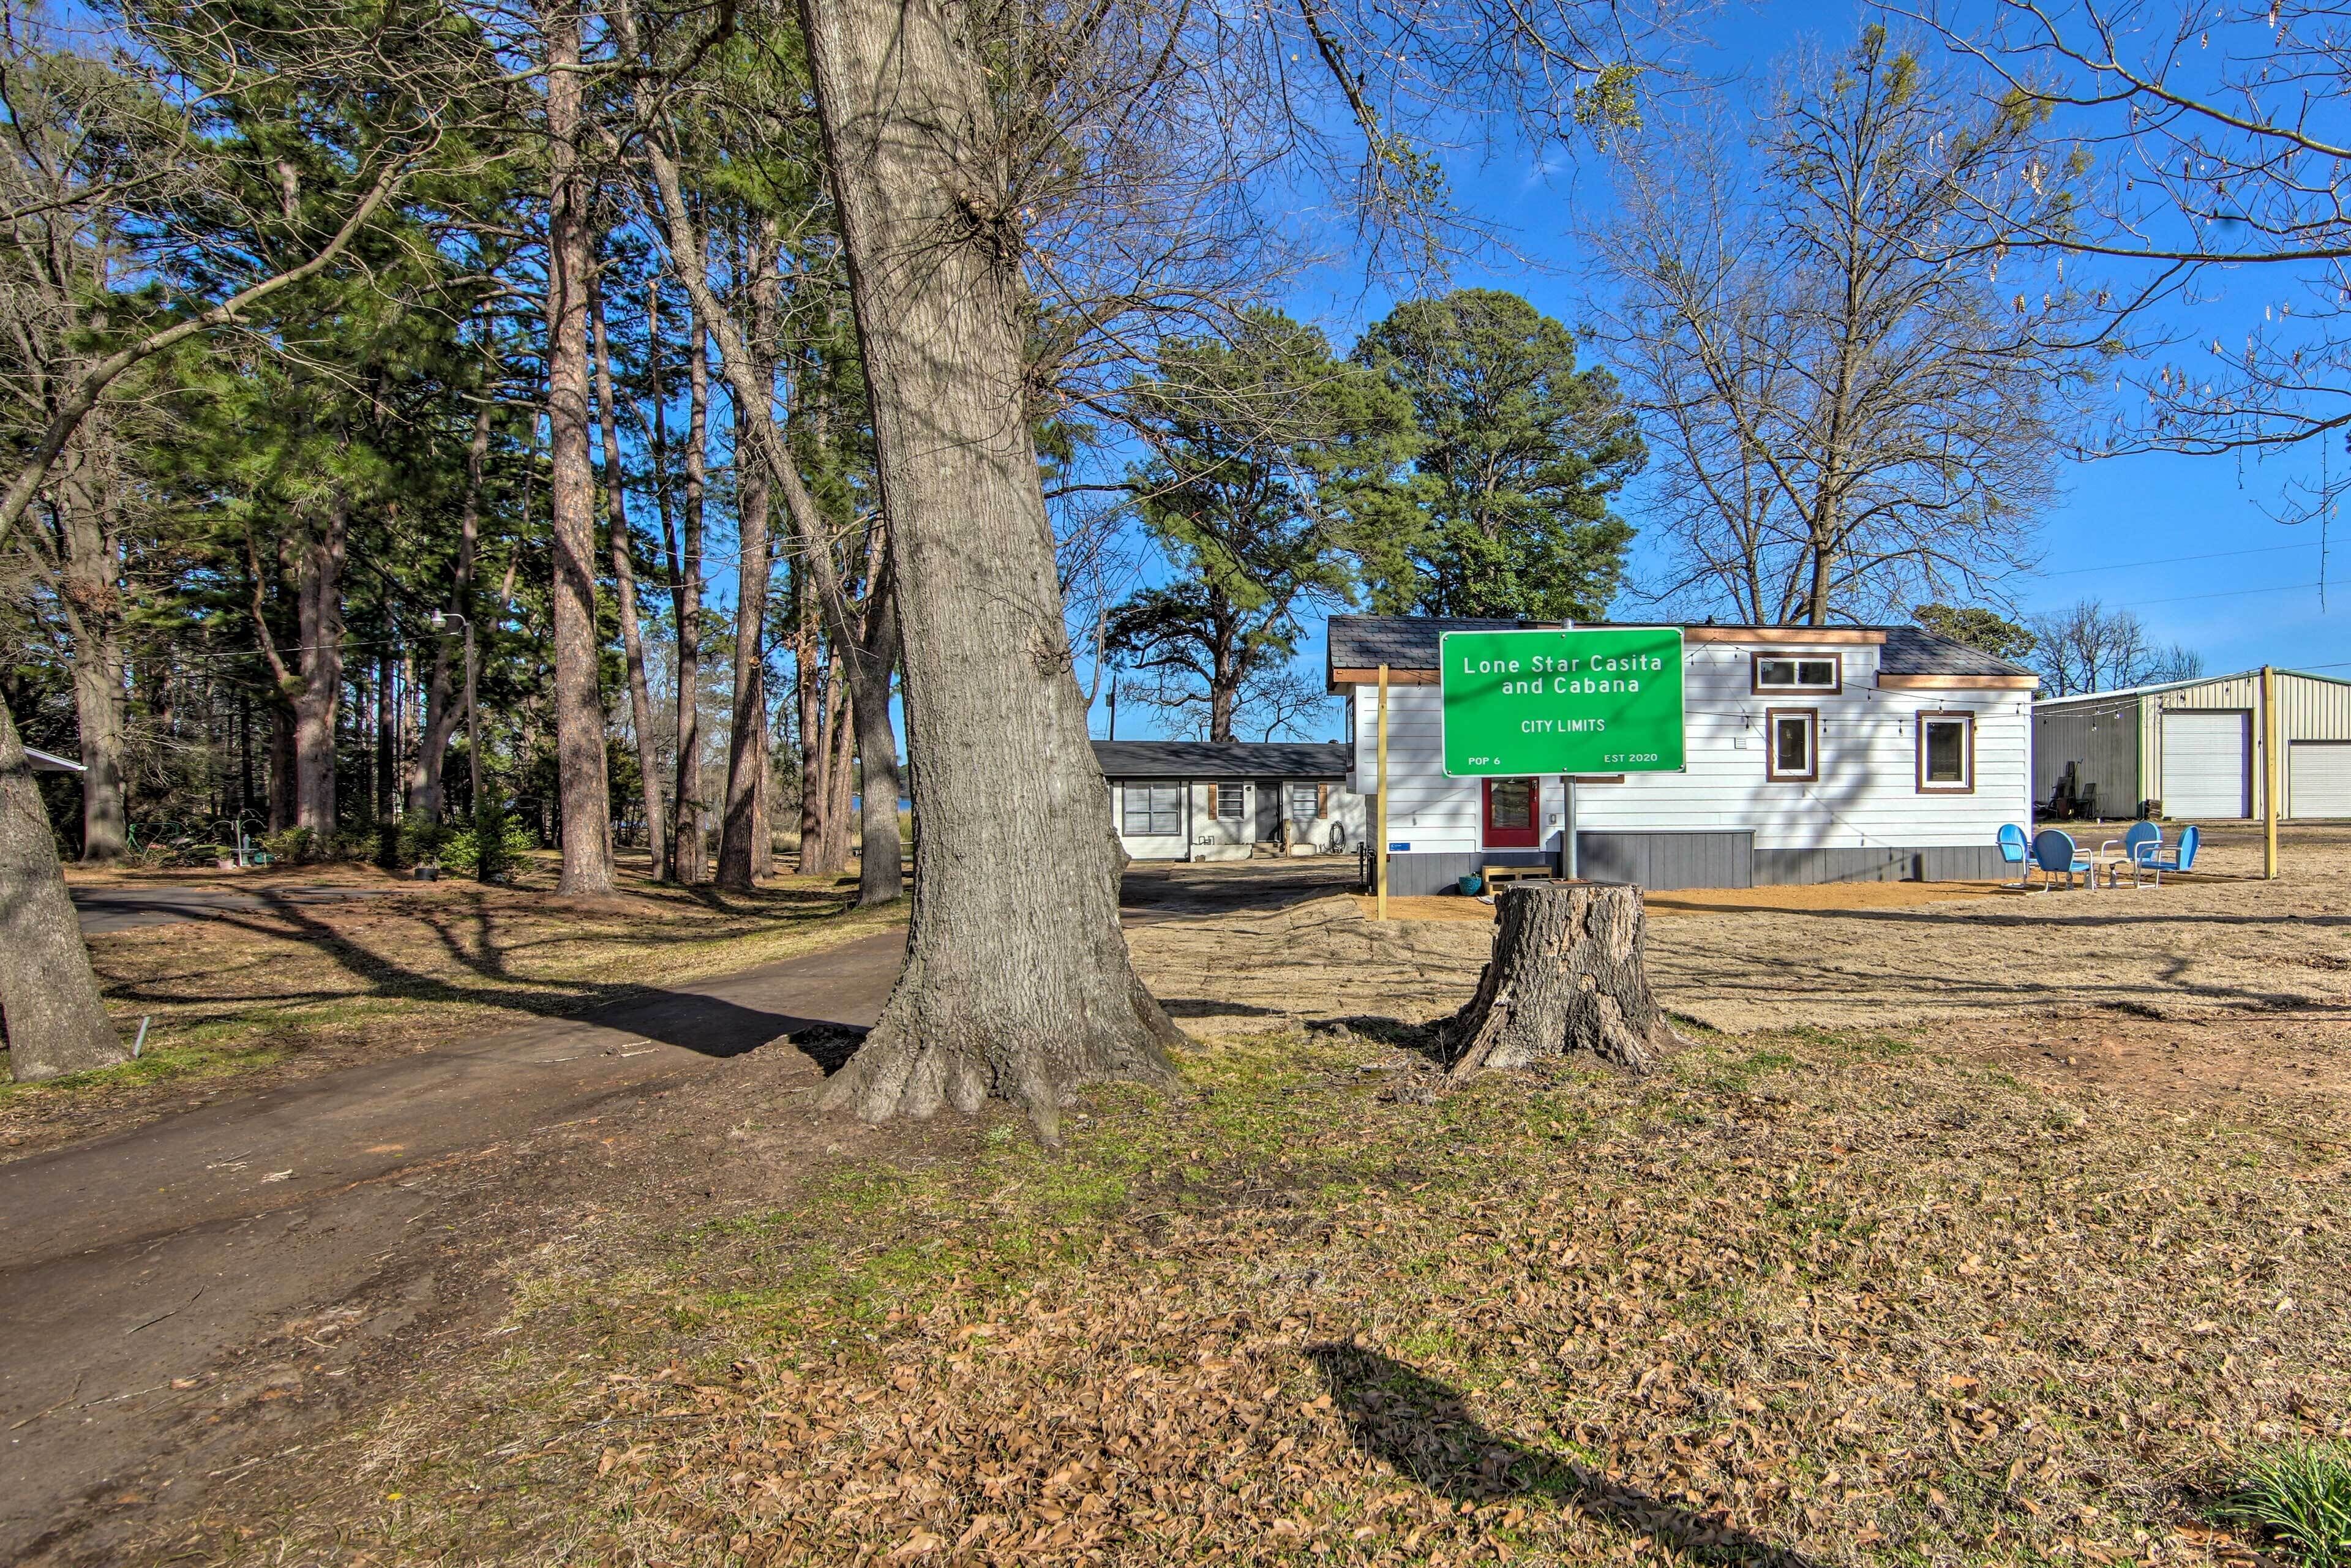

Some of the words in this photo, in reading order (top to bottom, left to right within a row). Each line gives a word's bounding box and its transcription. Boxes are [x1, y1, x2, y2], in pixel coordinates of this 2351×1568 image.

[1464, 657, 1520, 673] Lone
[1532, 656, 1579, 672] Star
[1591, 654, 1662, 672] Casita
[1502, 677, 1542, 694] and
[1554, 677, 1639, 694] Cabana
[1521, 720, 1553, 733] CITY
[1558, 719, 1605, 732] LIMITS
[1629, 753, 1657, 762] 2020
